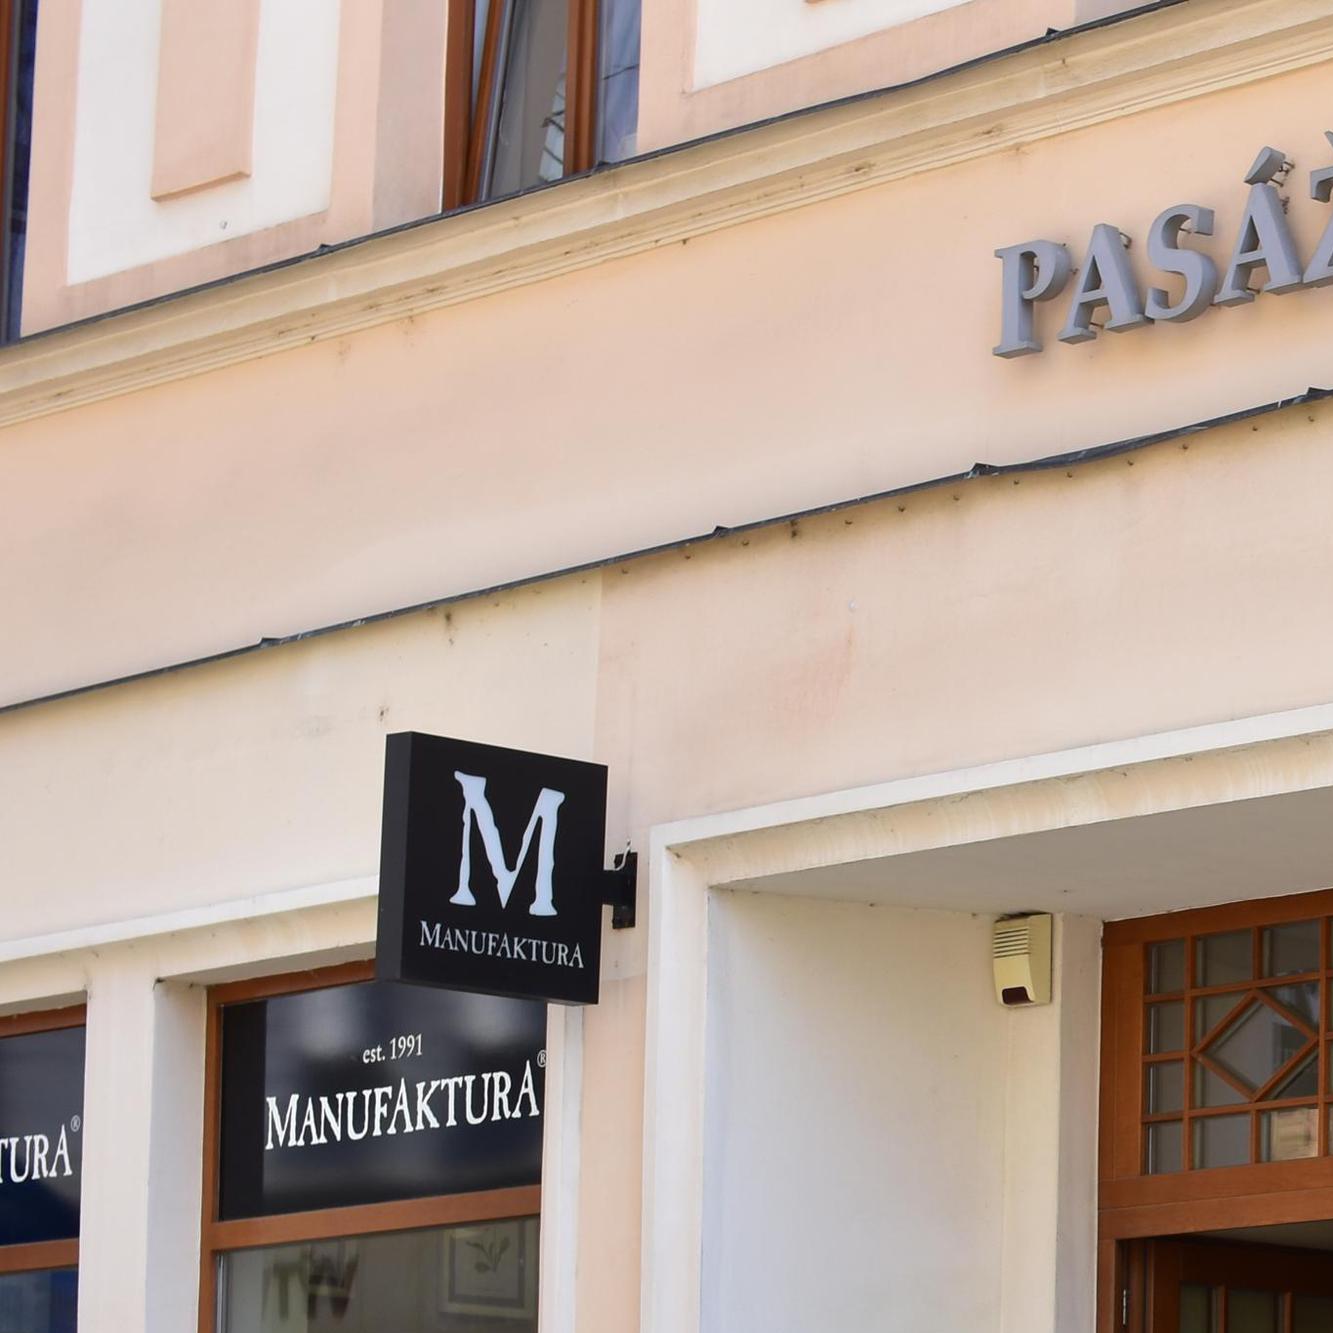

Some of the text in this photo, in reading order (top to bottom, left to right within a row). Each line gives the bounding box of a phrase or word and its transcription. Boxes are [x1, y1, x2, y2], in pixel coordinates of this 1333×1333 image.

[448, 770, 566, 917] M
[419, 920, 585, 969] MANUFAKTURA
[362, 1034, 423, 1064] est. 1991
